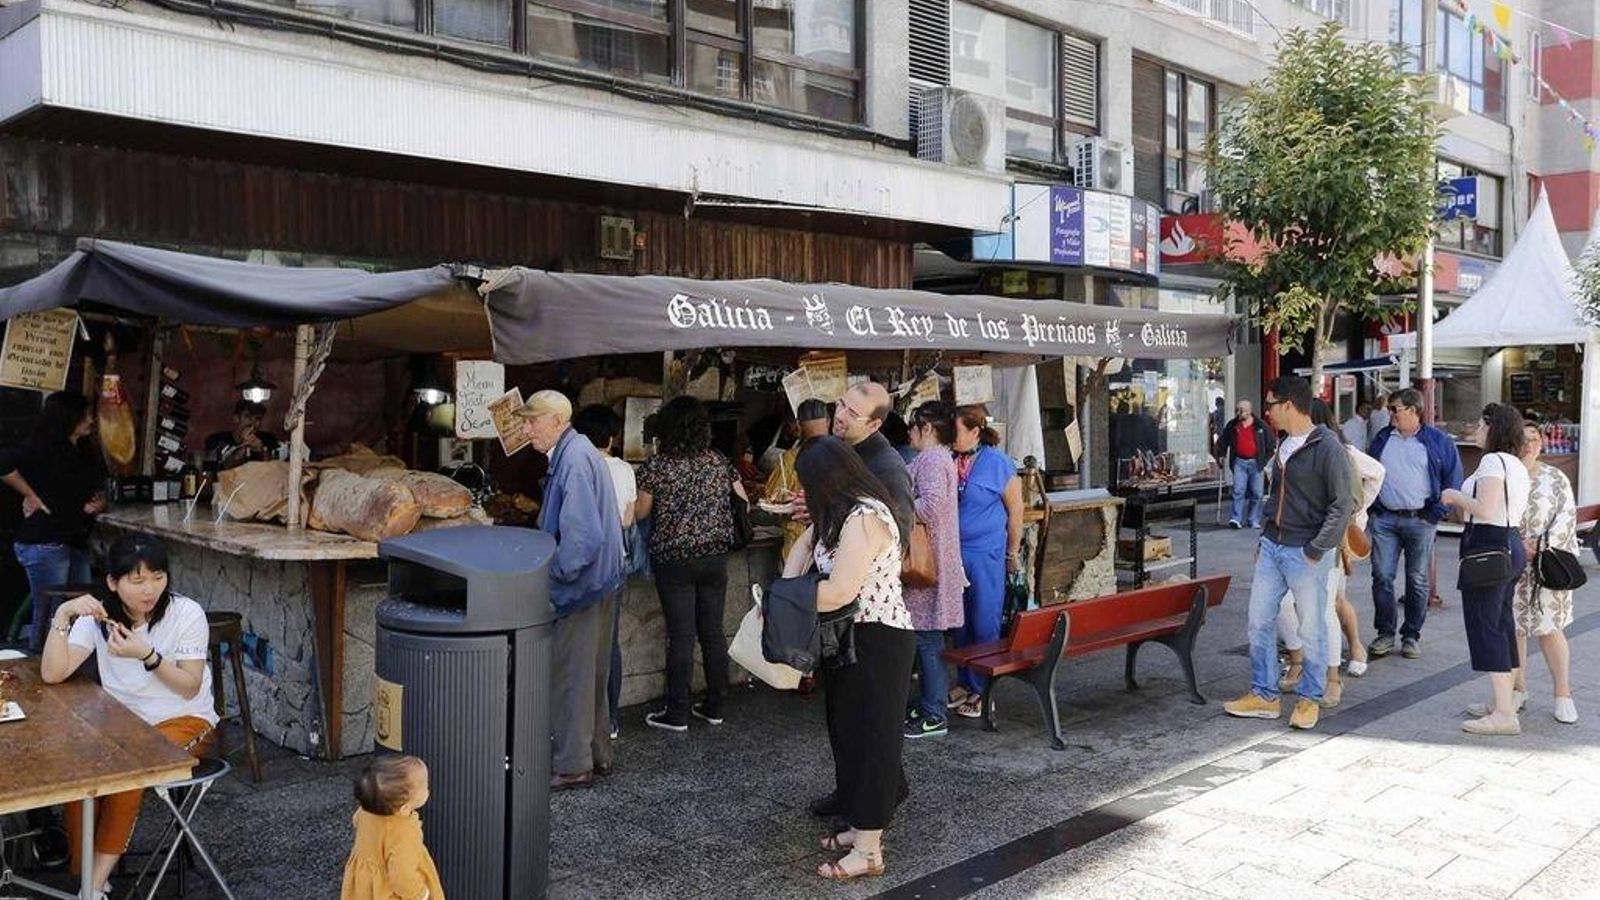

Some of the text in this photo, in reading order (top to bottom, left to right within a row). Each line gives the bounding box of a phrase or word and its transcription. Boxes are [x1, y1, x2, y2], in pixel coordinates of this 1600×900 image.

[667, 292, 774, 330] Galicia
[846, 305, 878, 337] El
[885, 307, 935, 343] Rey
[945, 312, 970, 339] de
[977, 312, 1010, 340] los
[1021, 313, 1097, 348] Preñaos
[1141, 322, 1189, 348] Galicia
